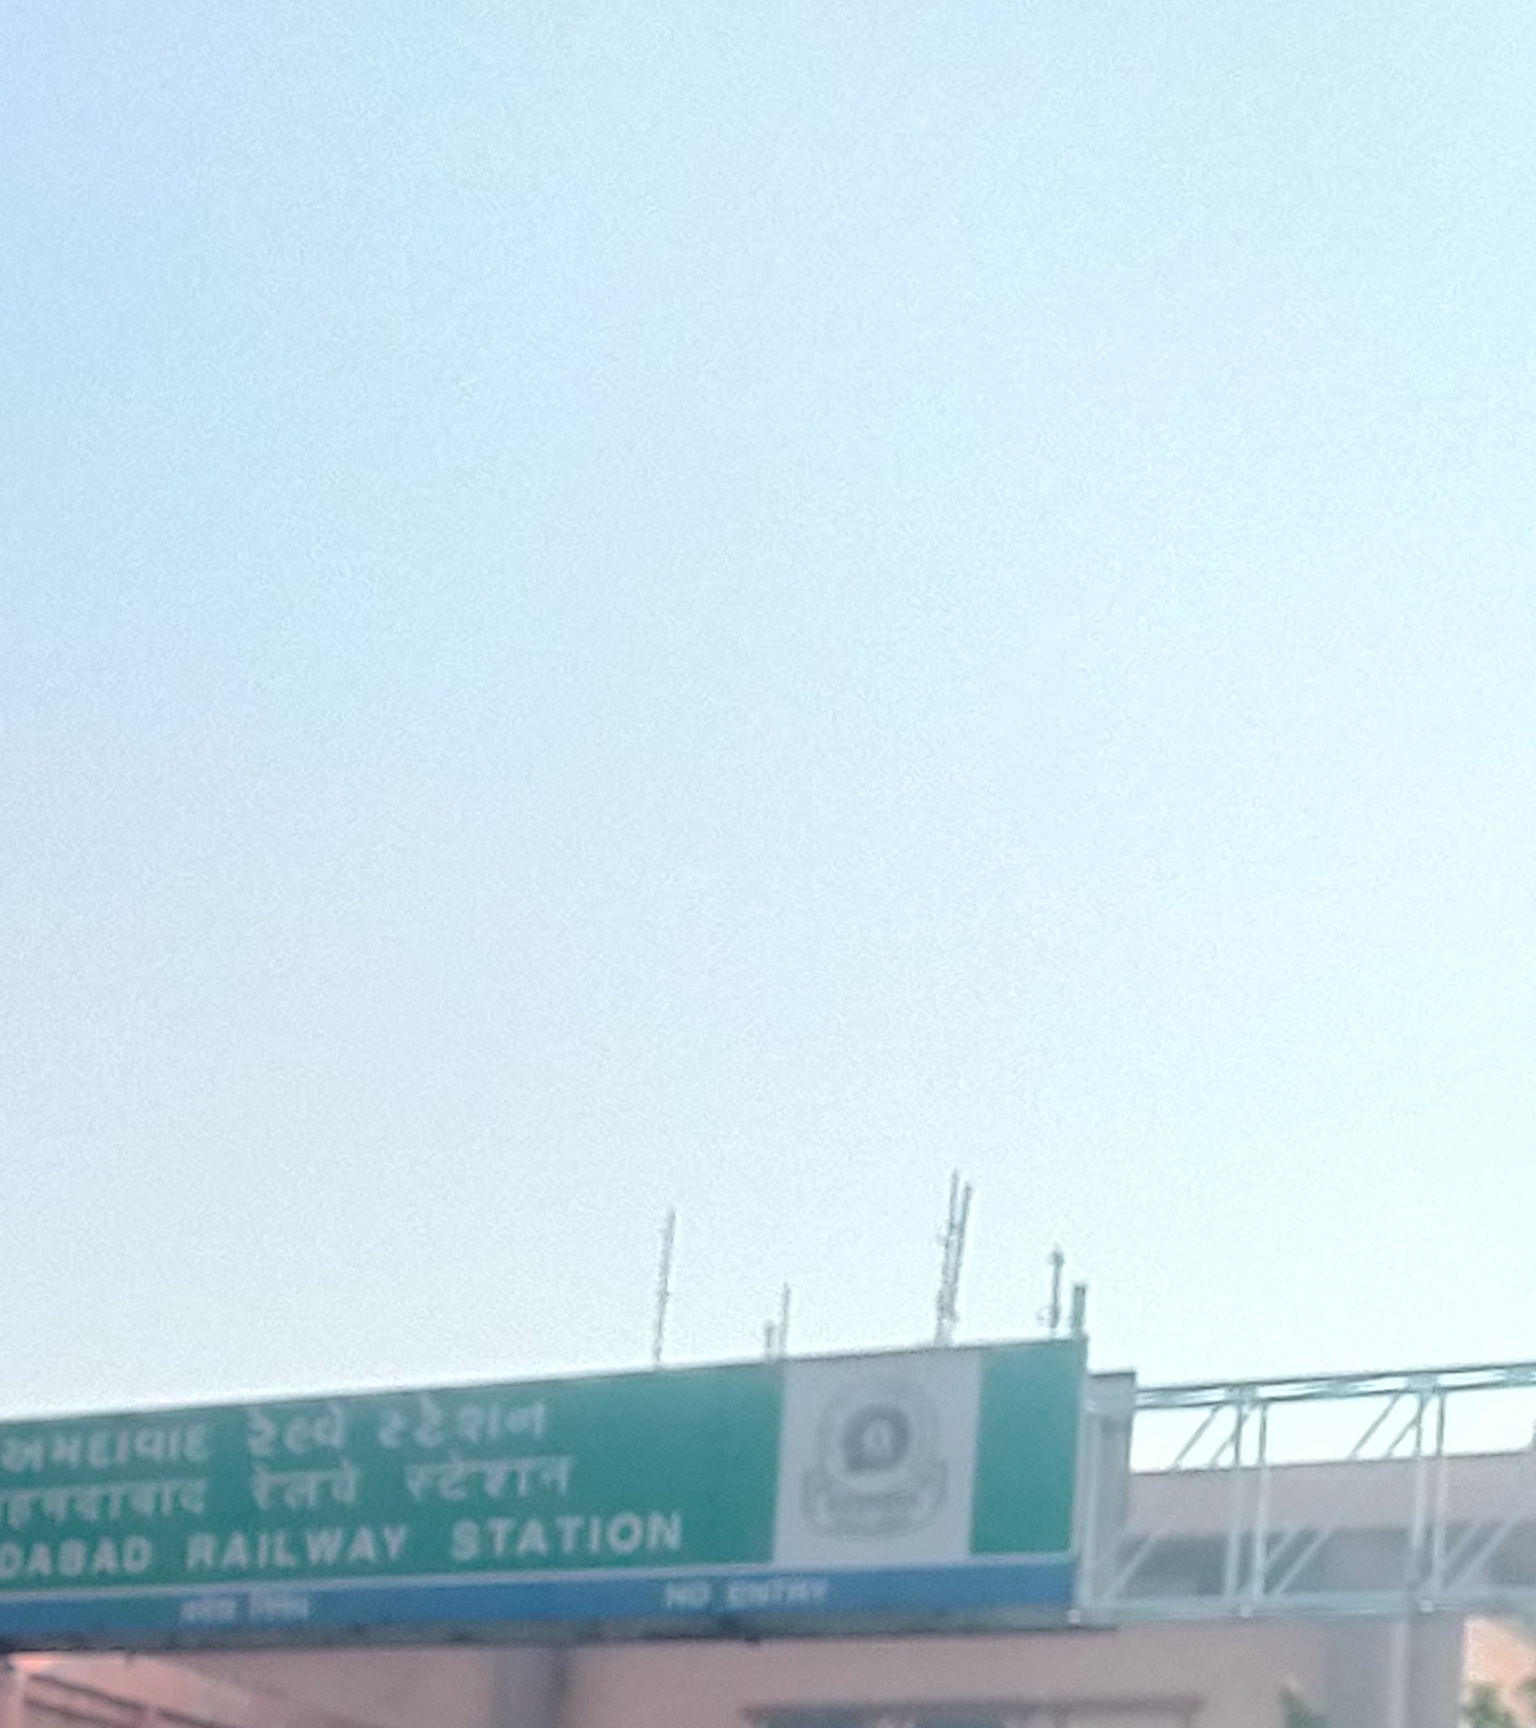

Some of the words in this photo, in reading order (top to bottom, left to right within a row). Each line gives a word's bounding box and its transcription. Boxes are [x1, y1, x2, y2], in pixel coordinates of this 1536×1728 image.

[0, 1421, 209, 1473] અમદાવાદ
[251, 1457, 360, 1509] रेलवे
[405, 1449, 574, 1501] स्टेशन
[185, 1525, 408, 1570] RAILWAY
[451, 1509, 683, 1562] STATION
